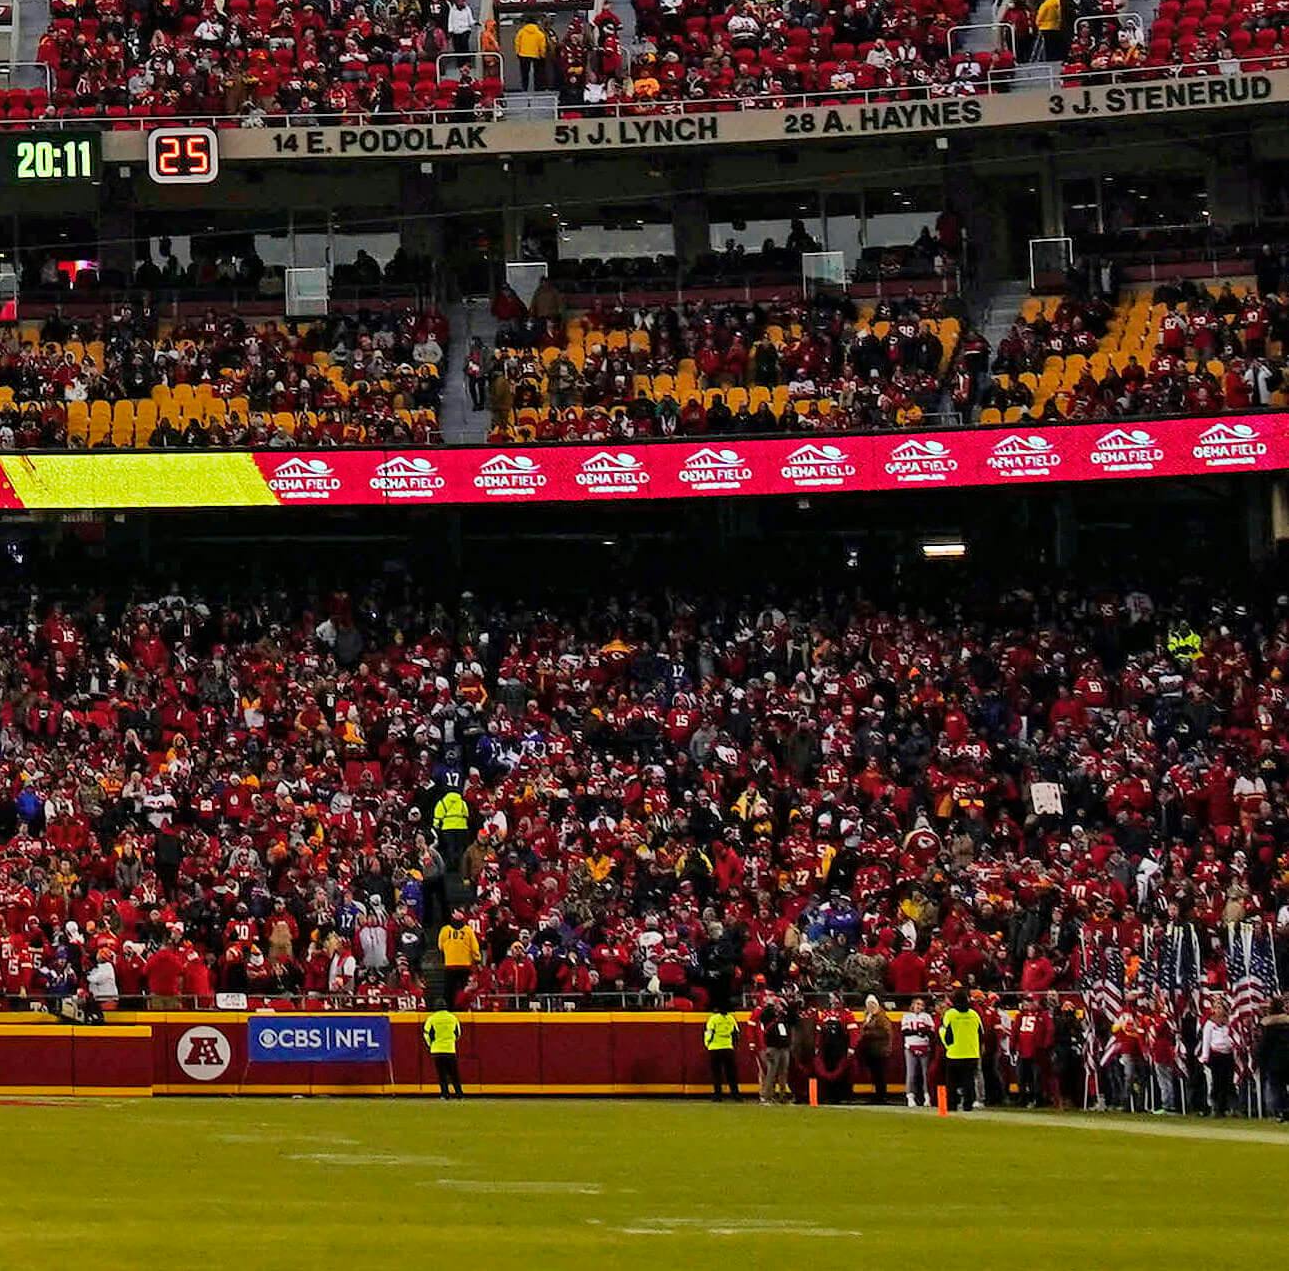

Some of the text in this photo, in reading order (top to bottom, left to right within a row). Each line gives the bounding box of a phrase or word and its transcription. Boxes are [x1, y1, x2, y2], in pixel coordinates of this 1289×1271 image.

[1049, 76, 1272, 115] 3 J. STENERUD
[783, 100, 982, 134] 28 A. HAYNES
[554, 116, 718, 145] 51 J. LYNCH
[273, 125, 487, 154] 14 E. PODOLAK
[17, 141, 91, 178] 20:11
[158, 137, 208, 174] 25
[1090, 449, 1164, 464] GEHA FIELD
[1193, 443, 1267, 458] GEHA FIELD
[268, 478, 341, 490] GEHA FIELD
[473, 475, 547, 488] GEHA FIELD
[575, 472, 650, 485] GEHA FIELD
[63, 631, 74, 642] 15
[676, 715, 688, 726] 15
[549, 742, 562, 753] 32
[447, 773, 459, 786] 17
[828, 770, 839, 783] 15
[236, 926, 248, 939] 10
[1021, 1017, 1035, 1031] 15
[282, 1029, 379, 1048] CBS NFL
